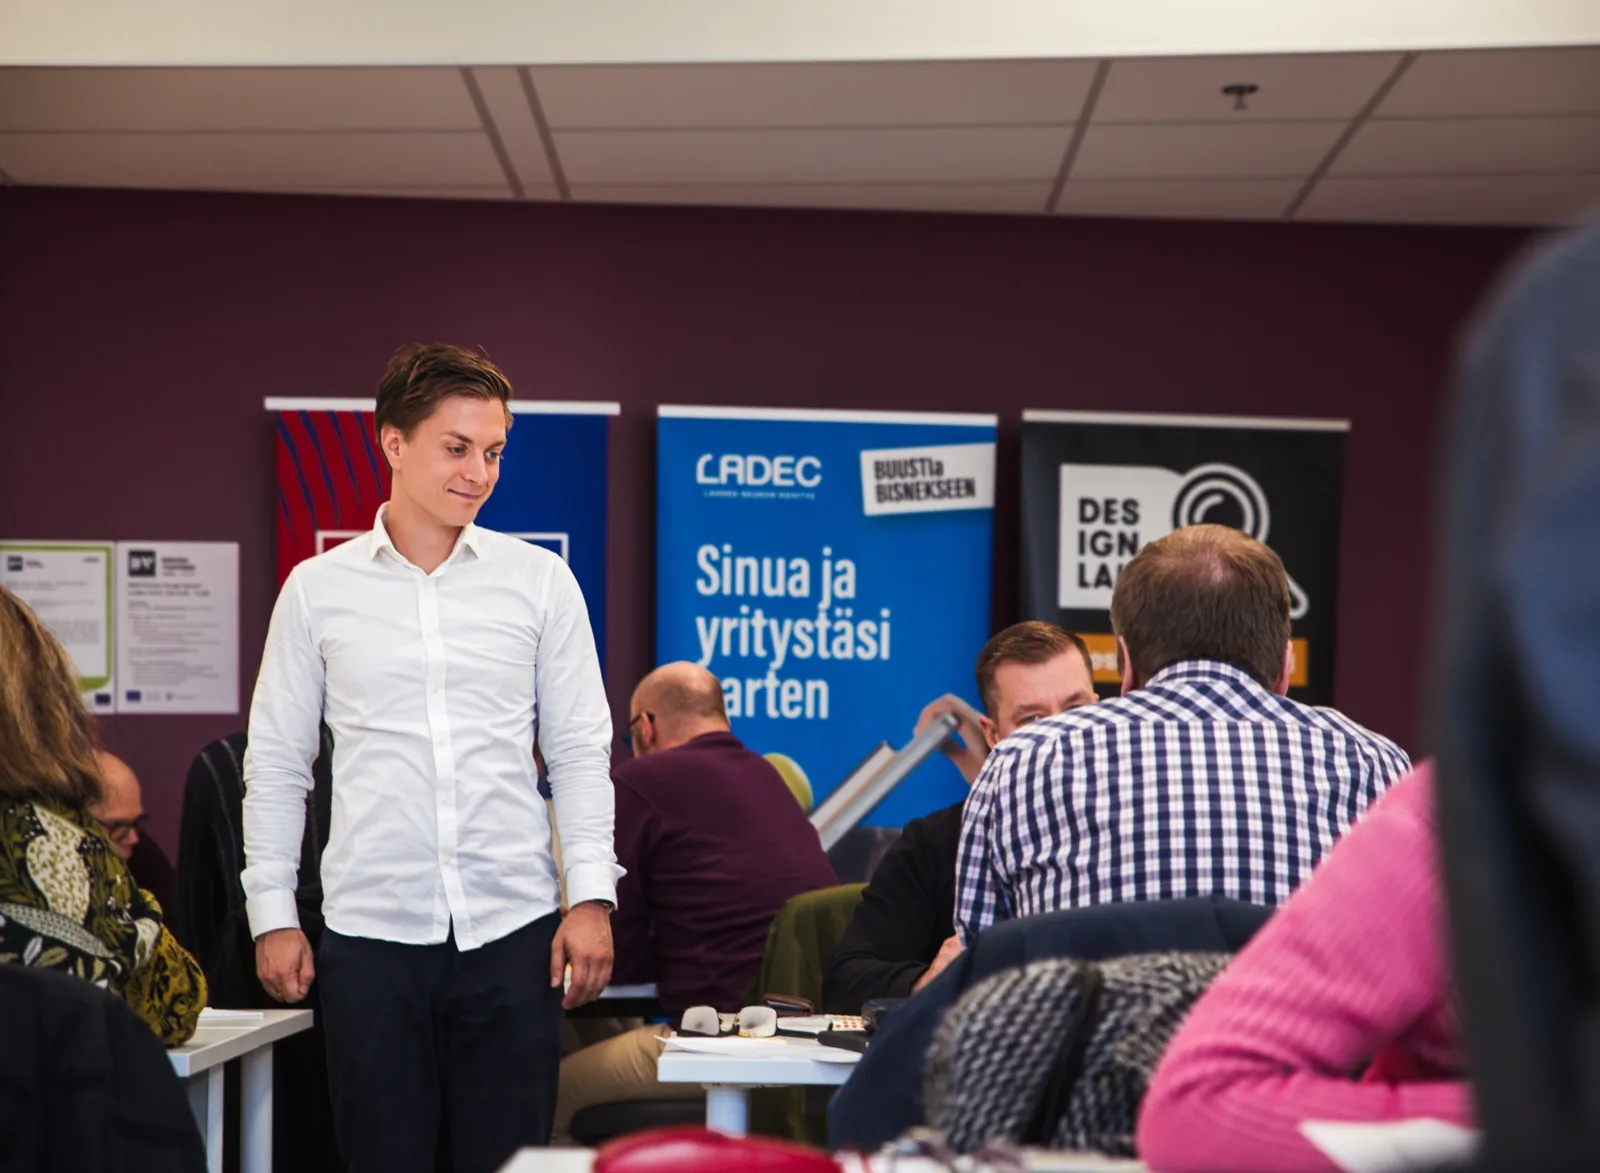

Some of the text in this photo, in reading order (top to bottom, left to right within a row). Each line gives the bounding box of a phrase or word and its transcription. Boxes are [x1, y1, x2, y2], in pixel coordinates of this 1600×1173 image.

[696, 453, 823, 488] LADEC
[876, 477, 976, 504] BISNEKSEEN
[1078, 496, 1141, 525] DES
[1078, 529, 1139, 557] IGN
[695, 543, 857, 610] Sinua ja
[1078, 561, 1123, 589] LA
[695, 604, 891, 671] yritystäsi
[721, 669, 830, 720] arten
